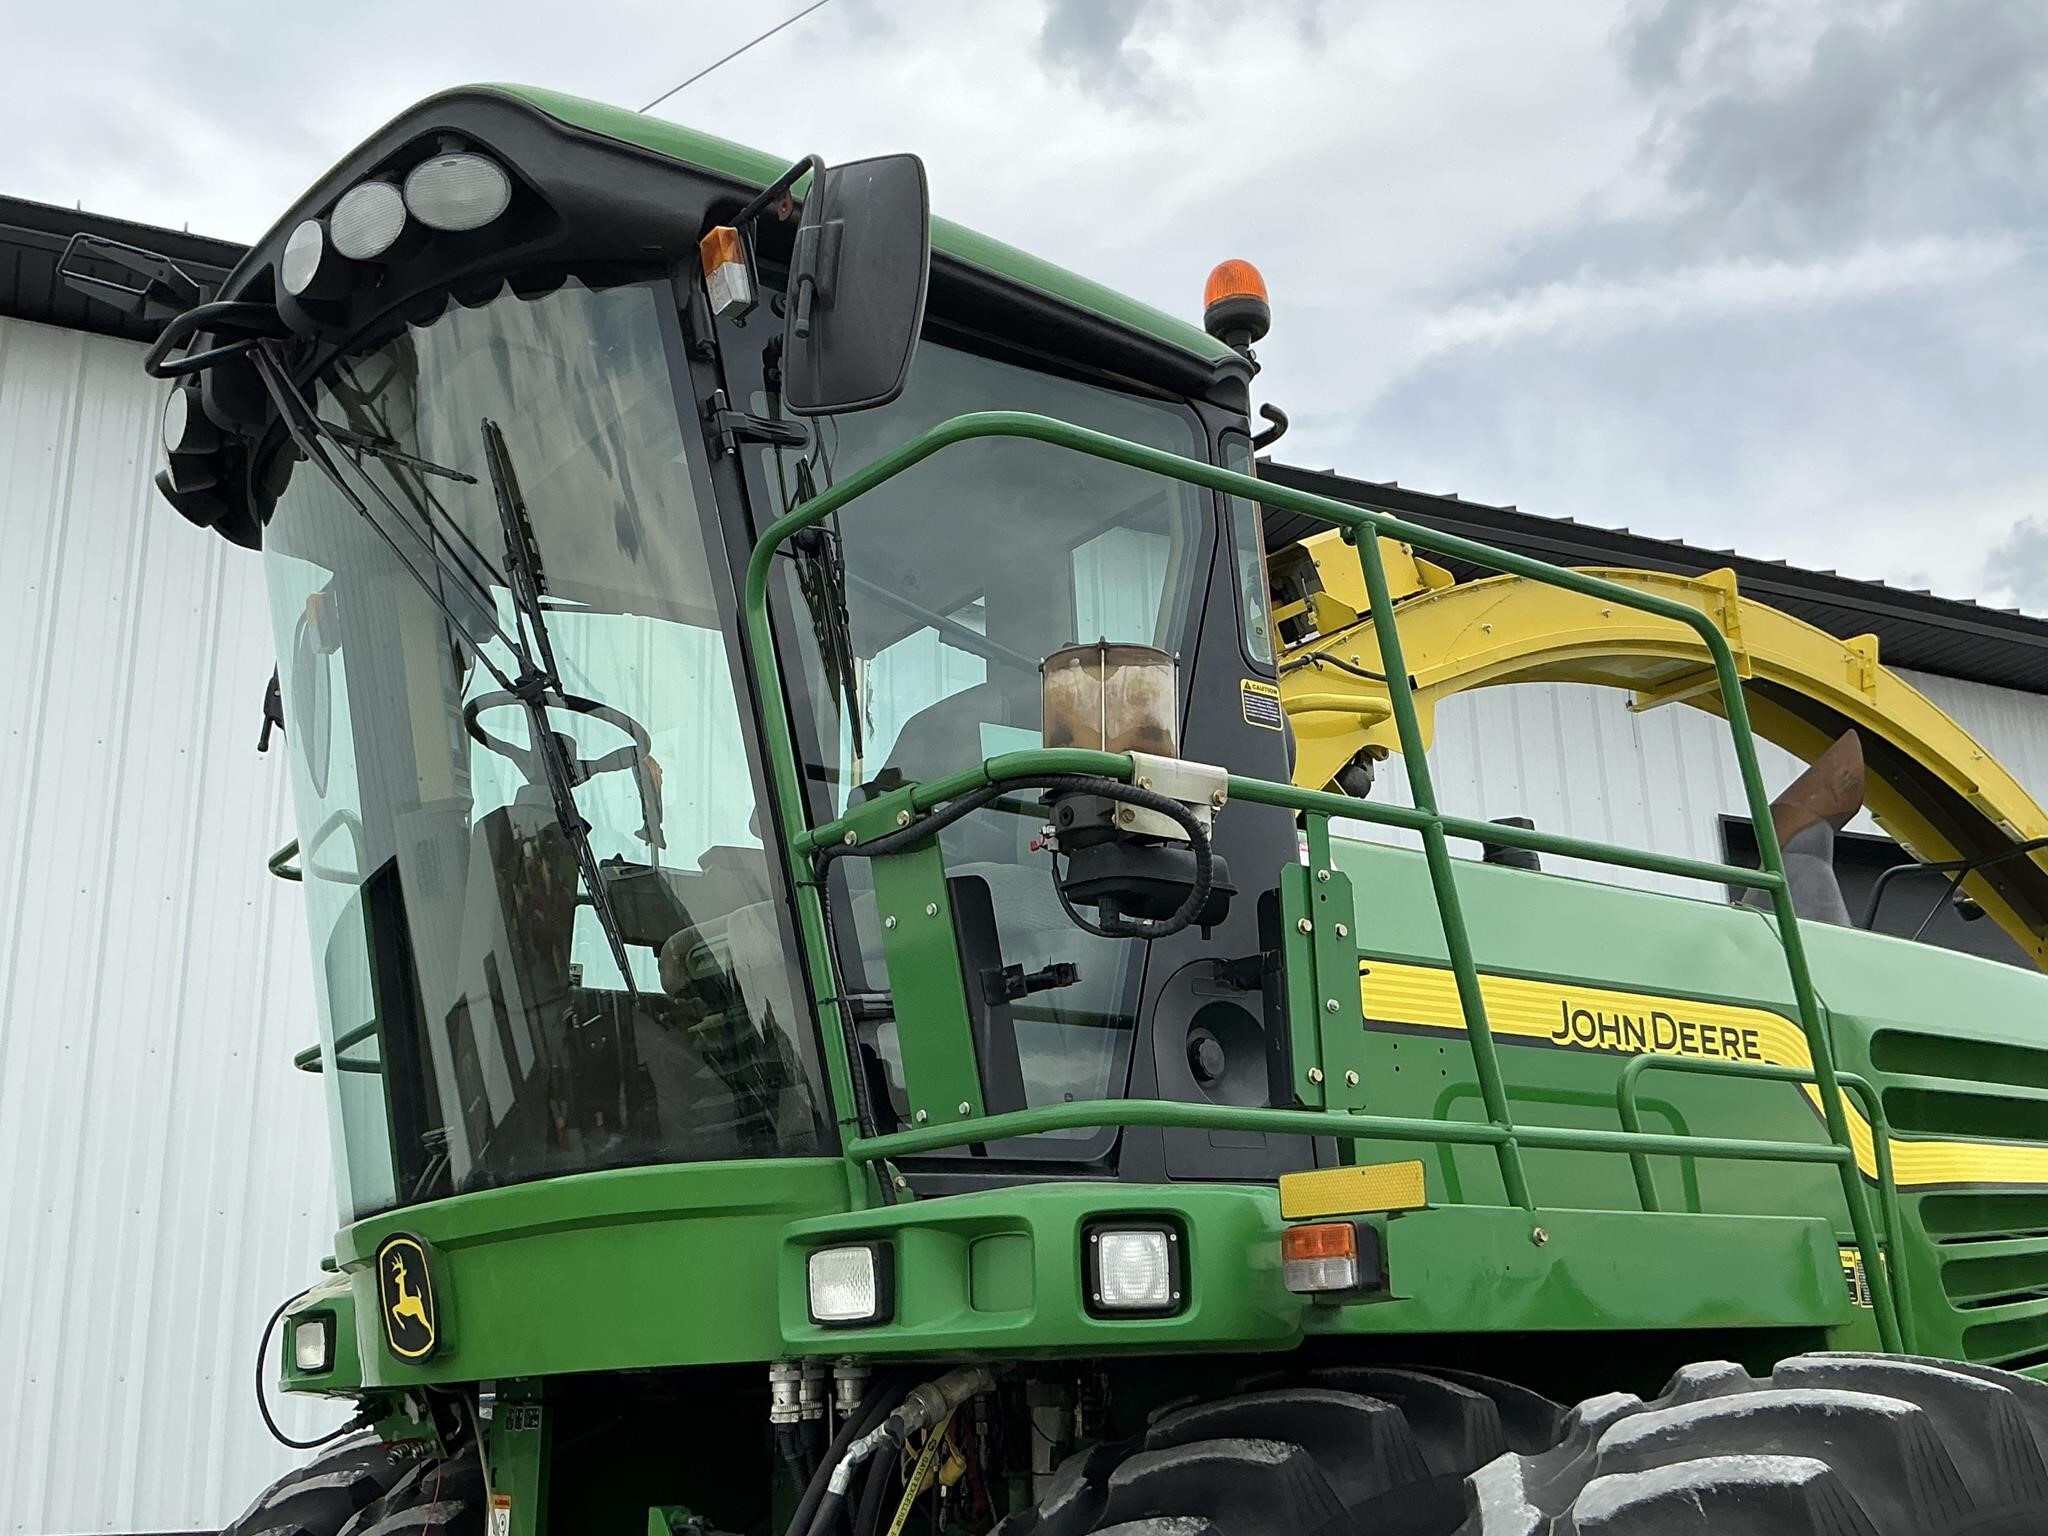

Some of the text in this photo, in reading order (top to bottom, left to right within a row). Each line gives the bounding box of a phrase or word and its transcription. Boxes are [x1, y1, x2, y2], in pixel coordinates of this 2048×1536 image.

[1252, 684, 1278, 695] CAUTION
[1552, 1000, 1762, 1060] JOHN DEERE
[914, 1456, 929, 1481] GATES
